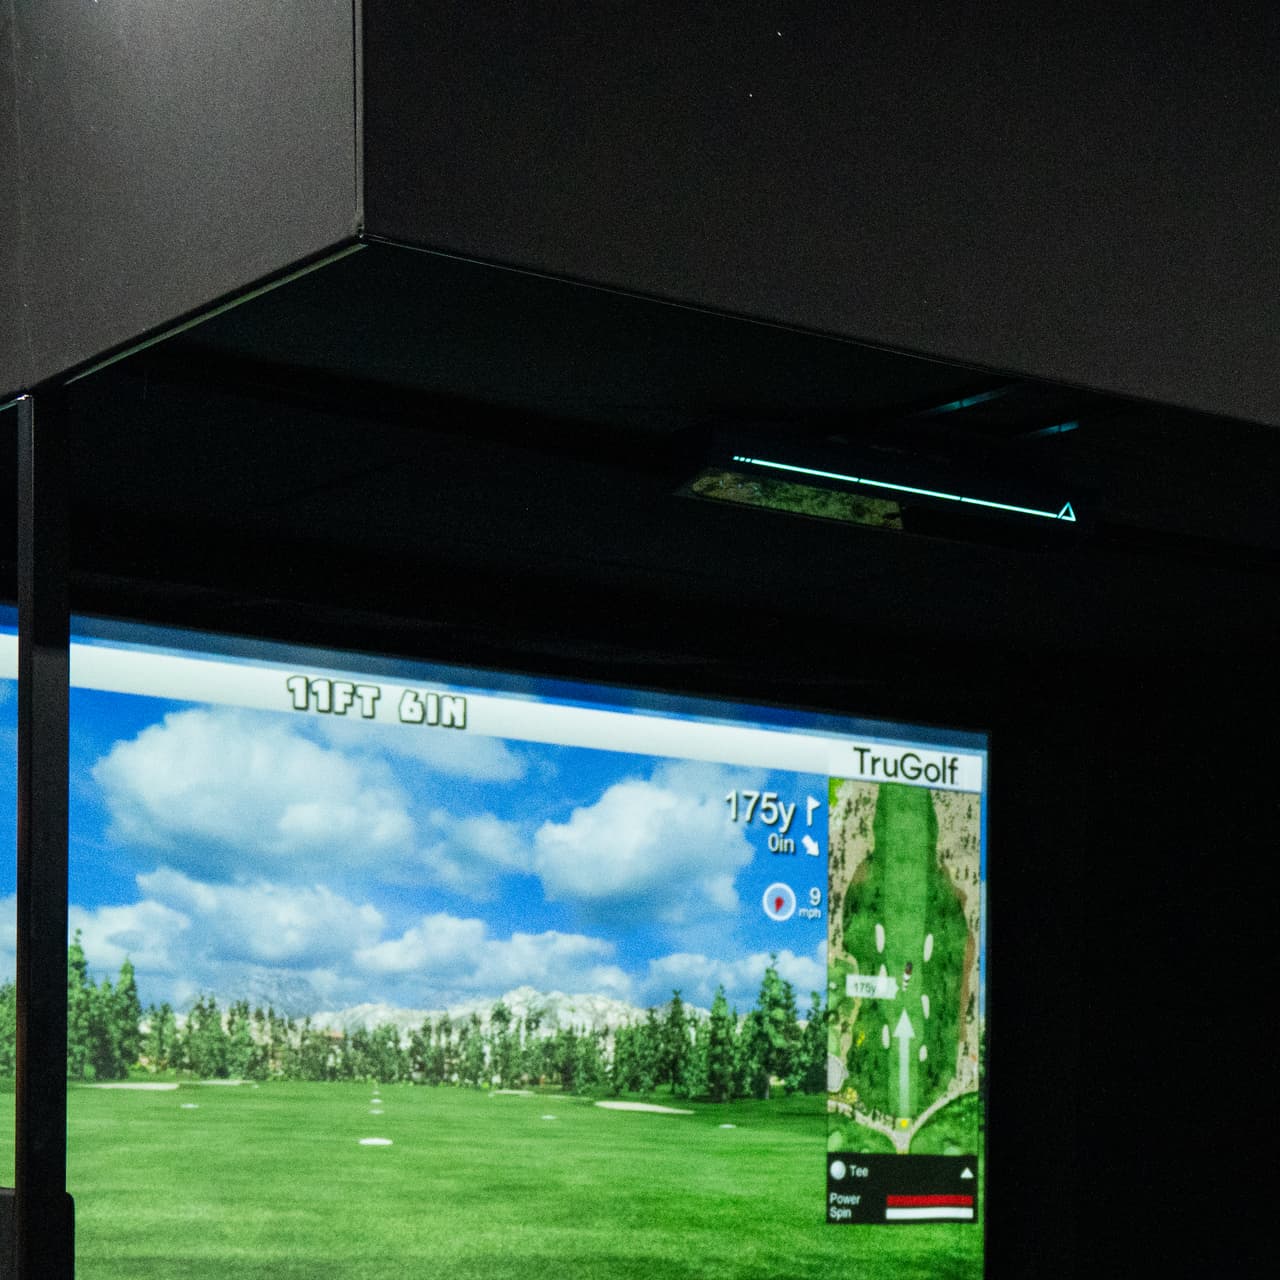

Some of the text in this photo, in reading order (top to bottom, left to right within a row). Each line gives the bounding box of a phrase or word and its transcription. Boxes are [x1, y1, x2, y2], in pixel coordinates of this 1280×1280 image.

[286, 675, 467, 730] 11FT 6IN
[853, 746, 959, 785] TruGolf
[725, 788, 796, 833] 175y
[767, 832, 795, 854] 0in
[809, 887, 822, 906] 9
[799, 906, 822, 920] mph
[854, 982, 877, 996] 175y
[849, 1165, 869, 1178] Tee
[829, 1192, 862, 1206] Power
[829, 1206, 852, 1221] Spin
